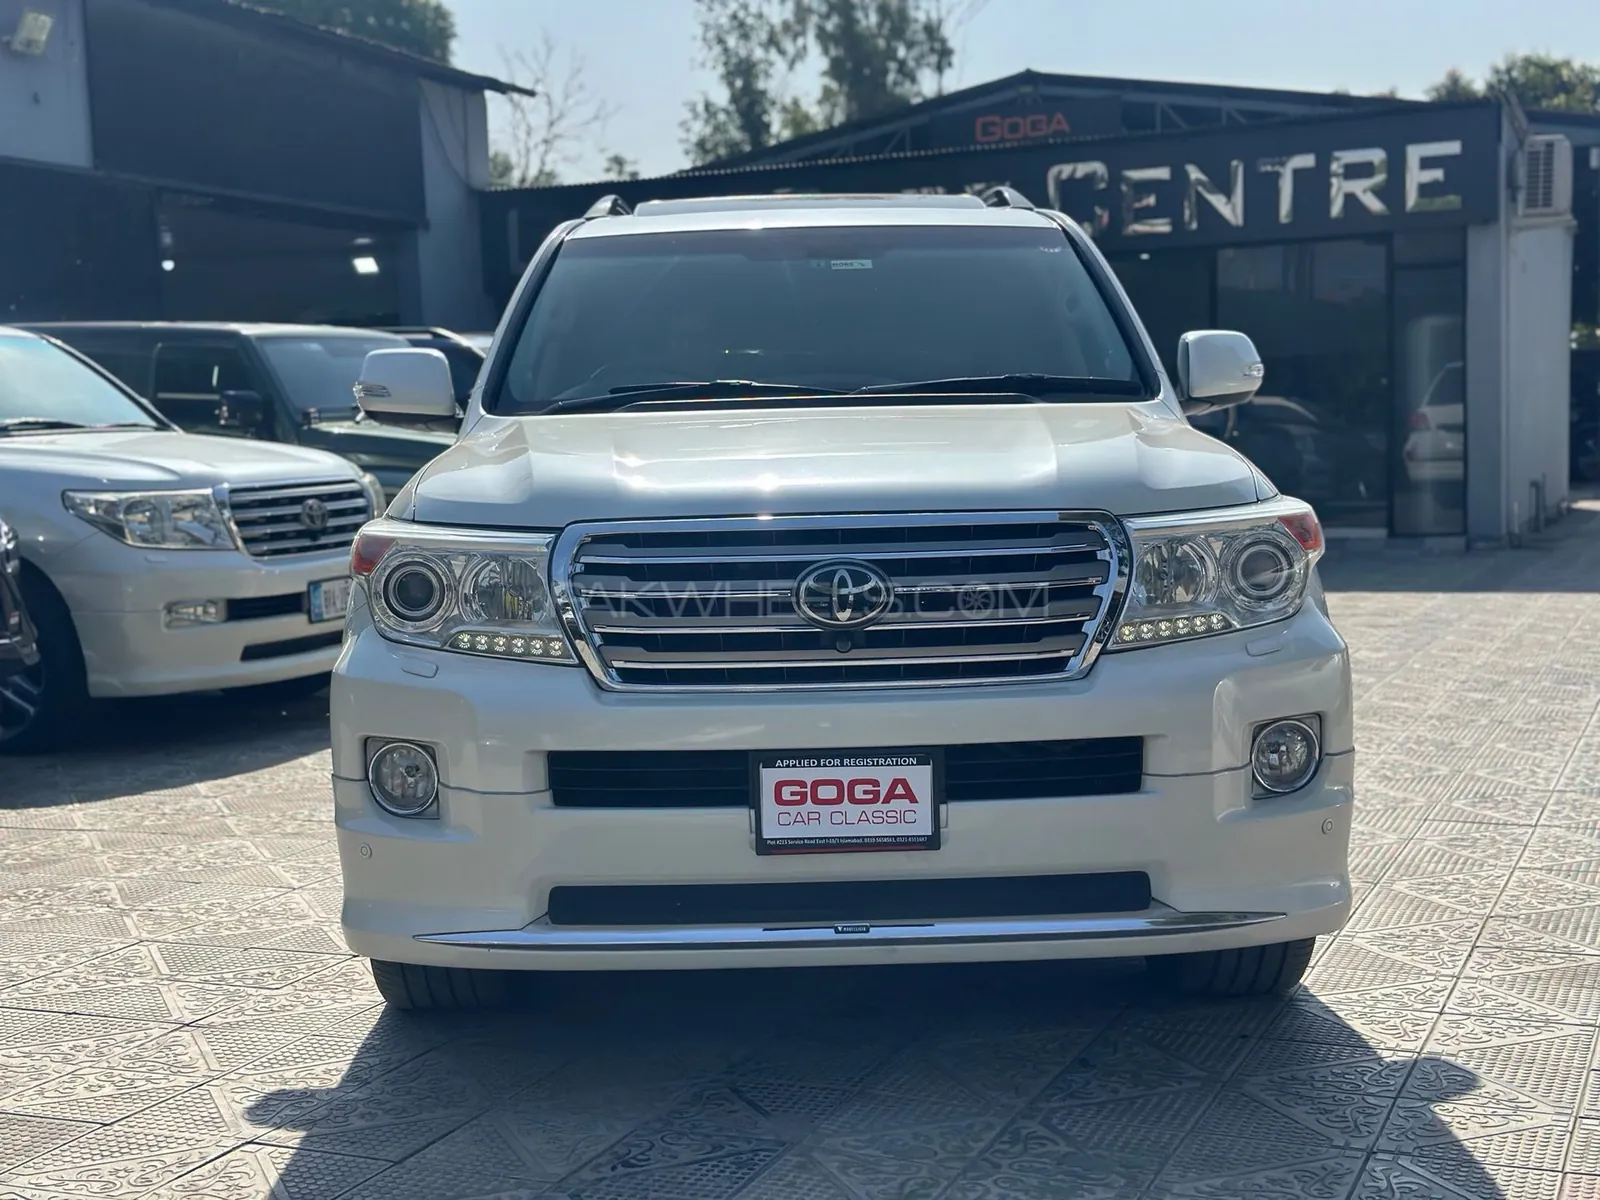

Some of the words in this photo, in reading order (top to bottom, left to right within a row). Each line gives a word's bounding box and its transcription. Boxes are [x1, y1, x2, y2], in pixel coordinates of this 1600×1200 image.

[974, 112, 1071, 143] GOGA
[1047, 139, 1463, 238] CENTRE
[775, 759, 818, 767] APPLIED
[820, 758, 841, 767] FOR
[843, 757, 917, 766] REGISTRATION
[774, 777, 919, 806] GOGA
[777, 811, 821, 826] CAR
[830, 809, 917, 825] CLASSIC
